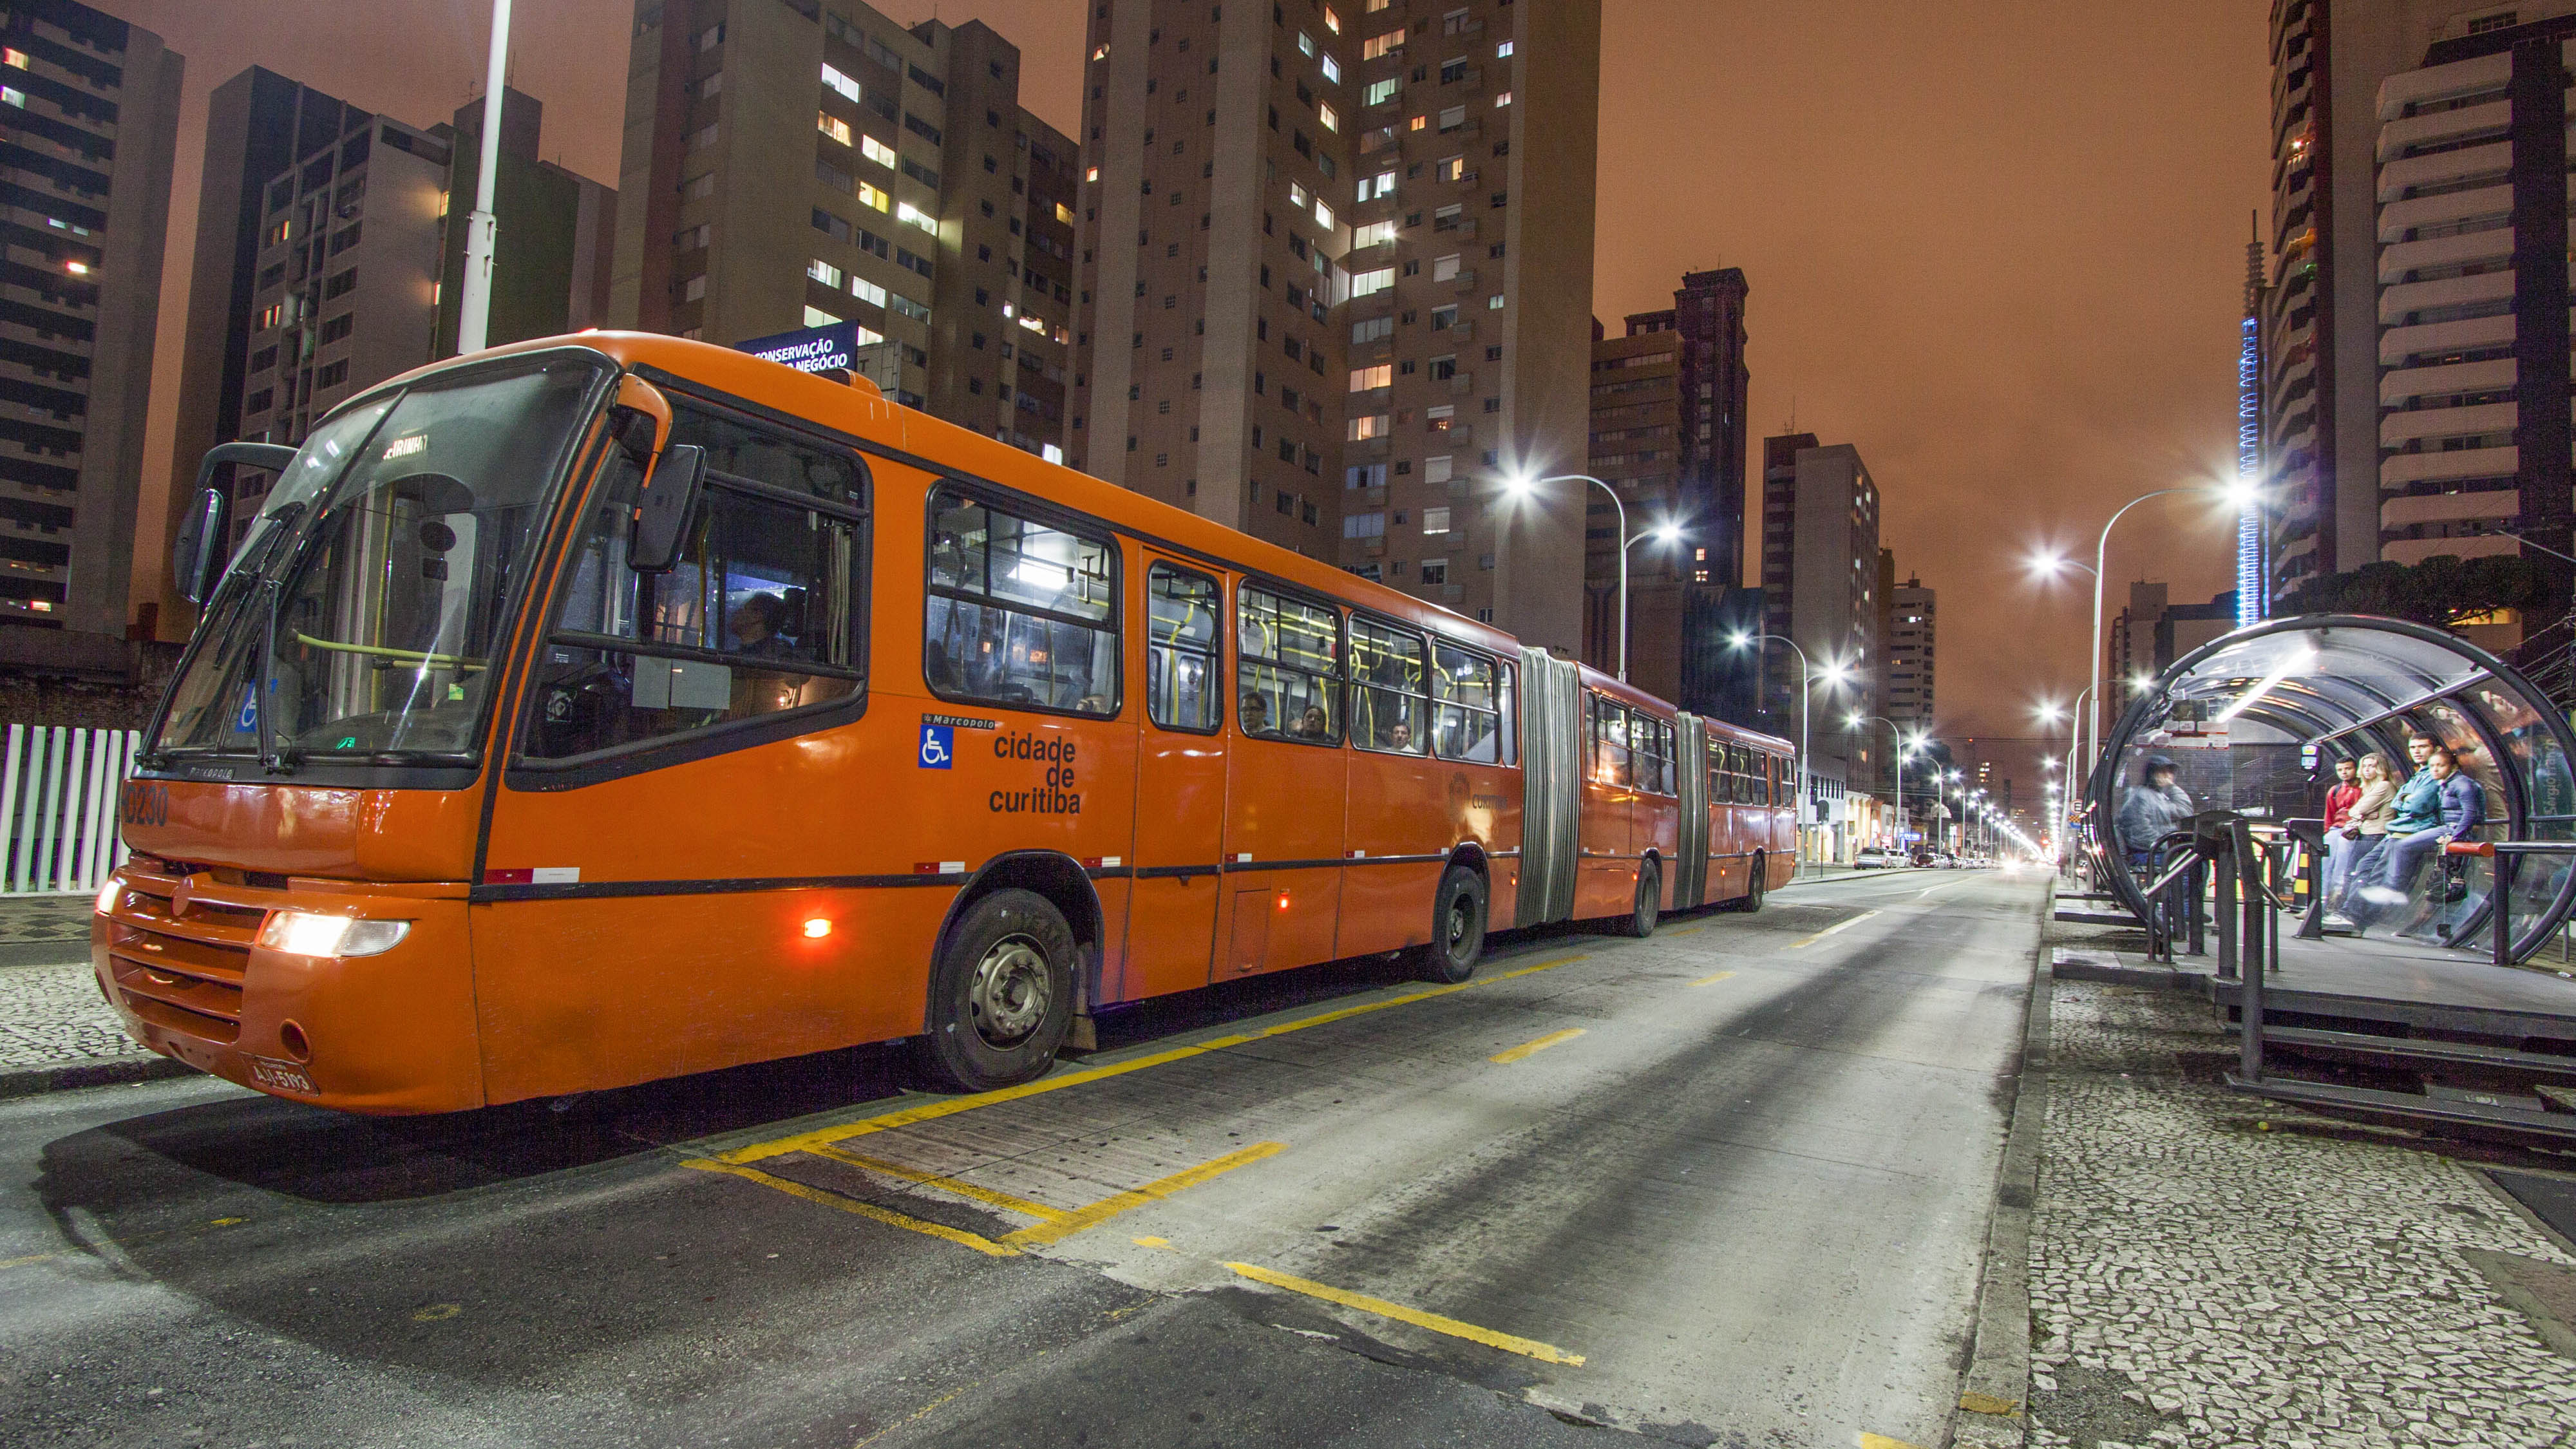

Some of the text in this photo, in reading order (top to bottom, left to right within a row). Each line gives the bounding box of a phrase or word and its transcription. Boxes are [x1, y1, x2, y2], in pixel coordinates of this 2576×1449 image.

[795, 354, 848, 372] NEGÓCIO
[933, 715, 994, 729] Marcopolo
[994, 732, 1075, 762] cidade
[1046, 762, 1074, 788] de
[990, 787, 1081, 814] curitiba
